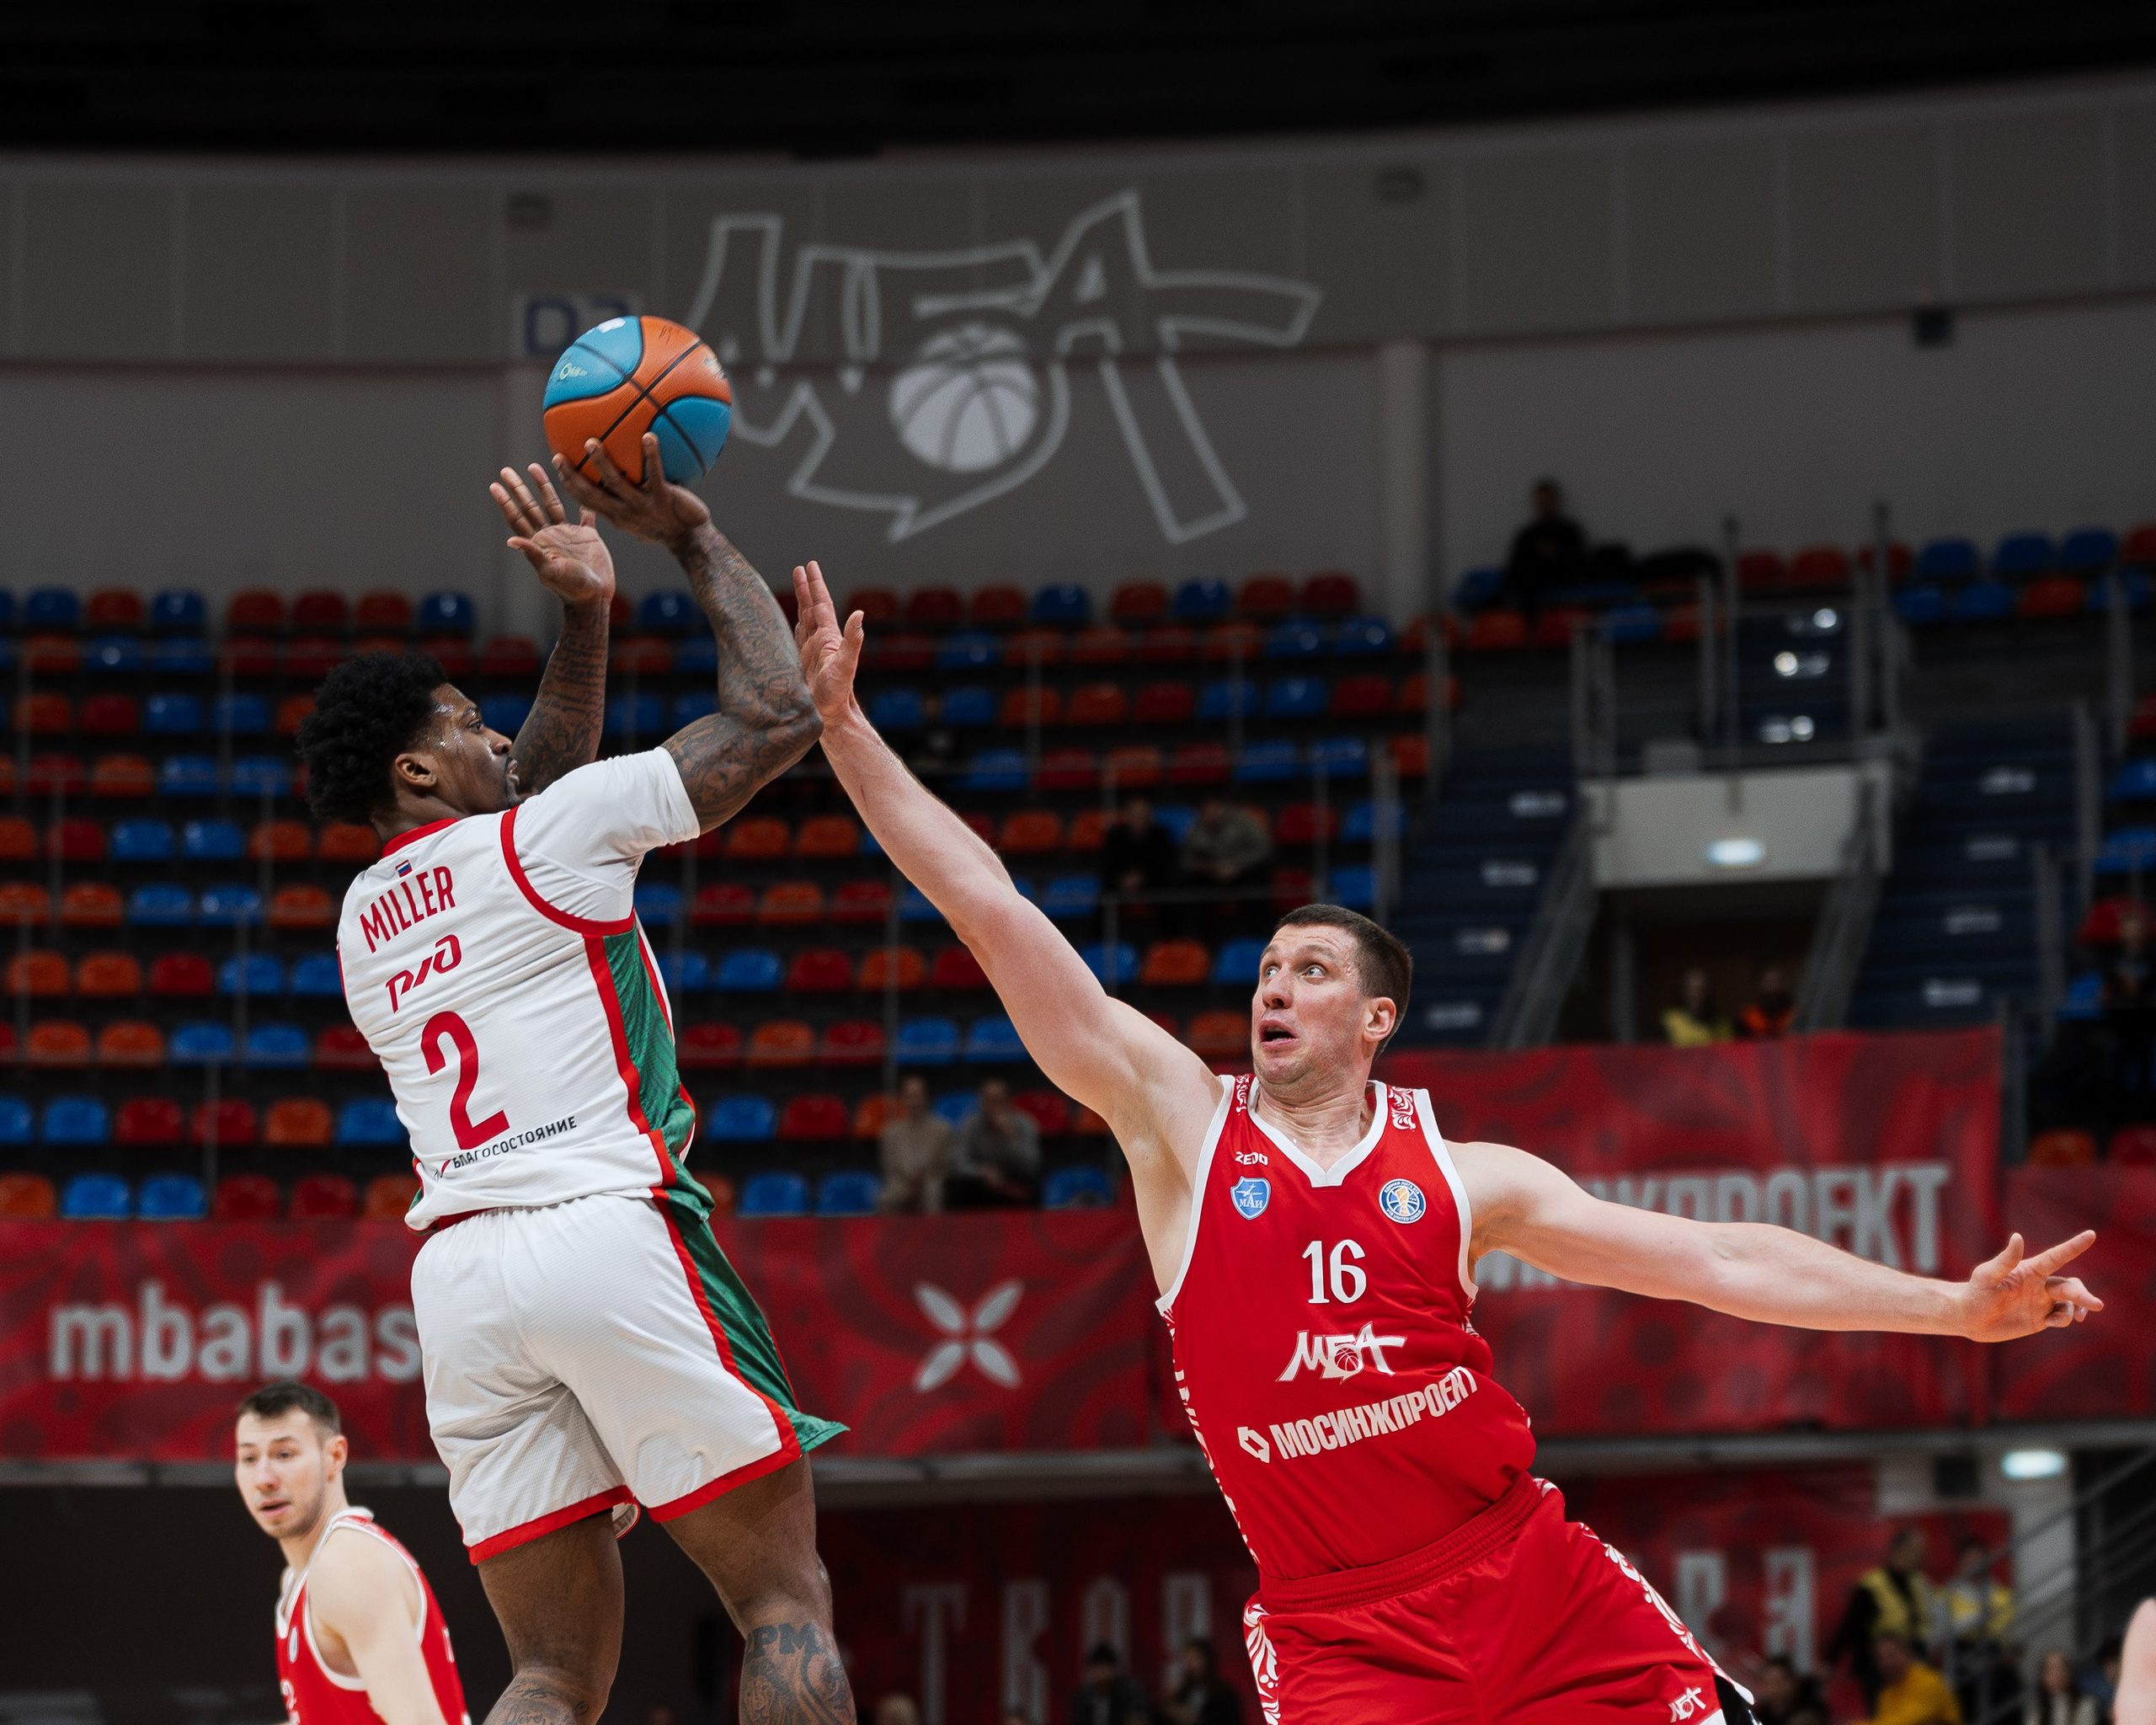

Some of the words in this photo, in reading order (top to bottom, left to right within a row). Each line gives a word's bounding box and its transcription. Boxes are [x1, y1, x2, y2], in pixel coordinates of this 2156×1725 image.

[360, 865, 456, 953] MILLER
[421, 1011, 510, 1151] 2
[452, 1115, 578, 1169] БЛАГОСОСТОЯНИЕ
[1239, 1193, 1263, 1209] МАИ
[1302, 1239, 1367, 1304] 16
[1269, 1365, 1479, 1461] МОСИНЖПРОЕКТ
